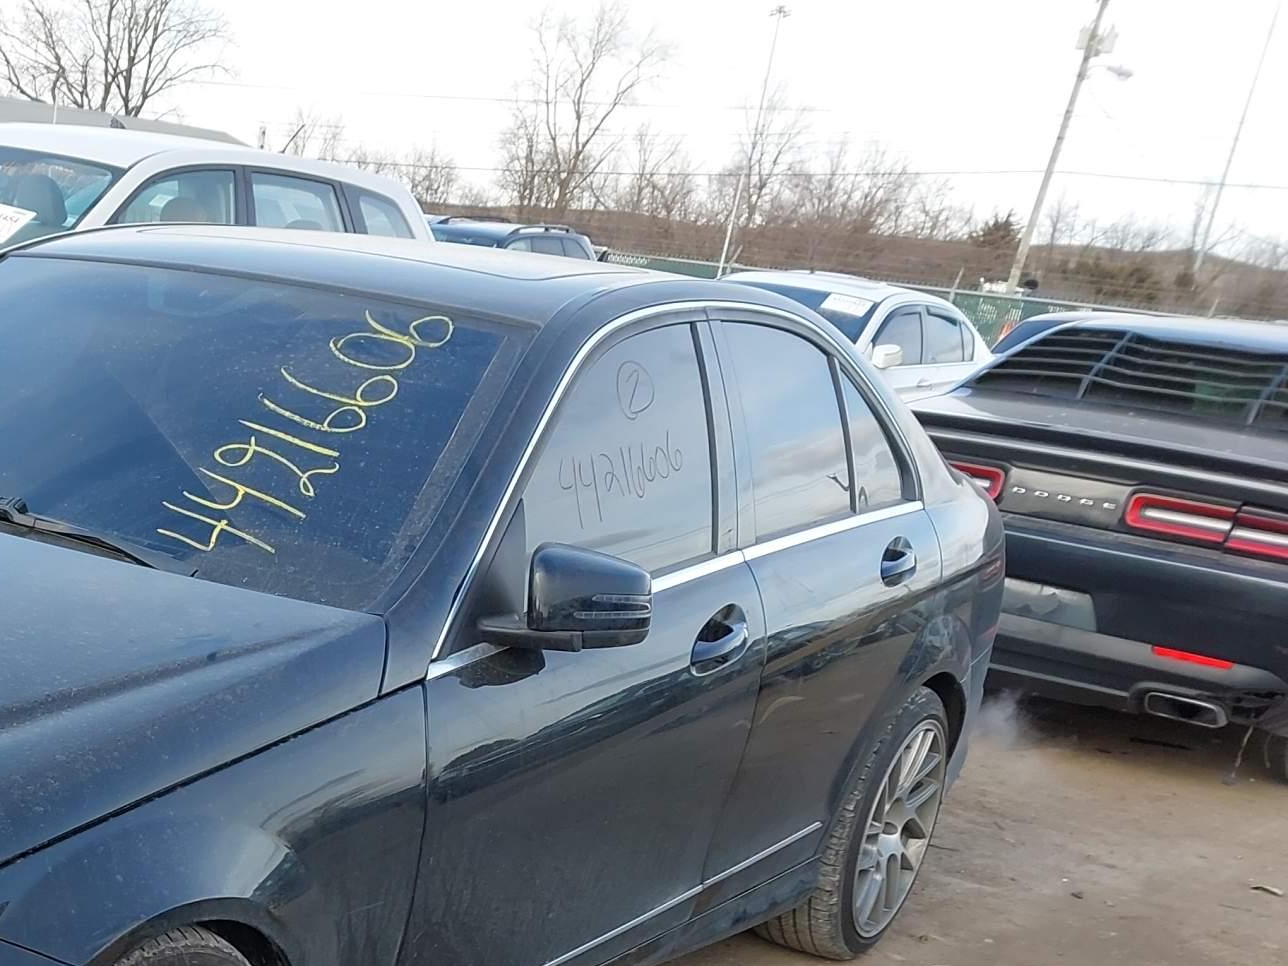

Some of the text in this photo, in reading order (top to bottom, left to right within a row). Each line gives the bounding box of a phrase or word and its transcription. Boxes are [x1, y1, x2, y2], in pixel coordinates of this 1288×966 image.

[156, 309, 454, 554] 44216606
[558, 429, 683, 530] 44216606
[1012, 486, 1117, 510] DODGE
